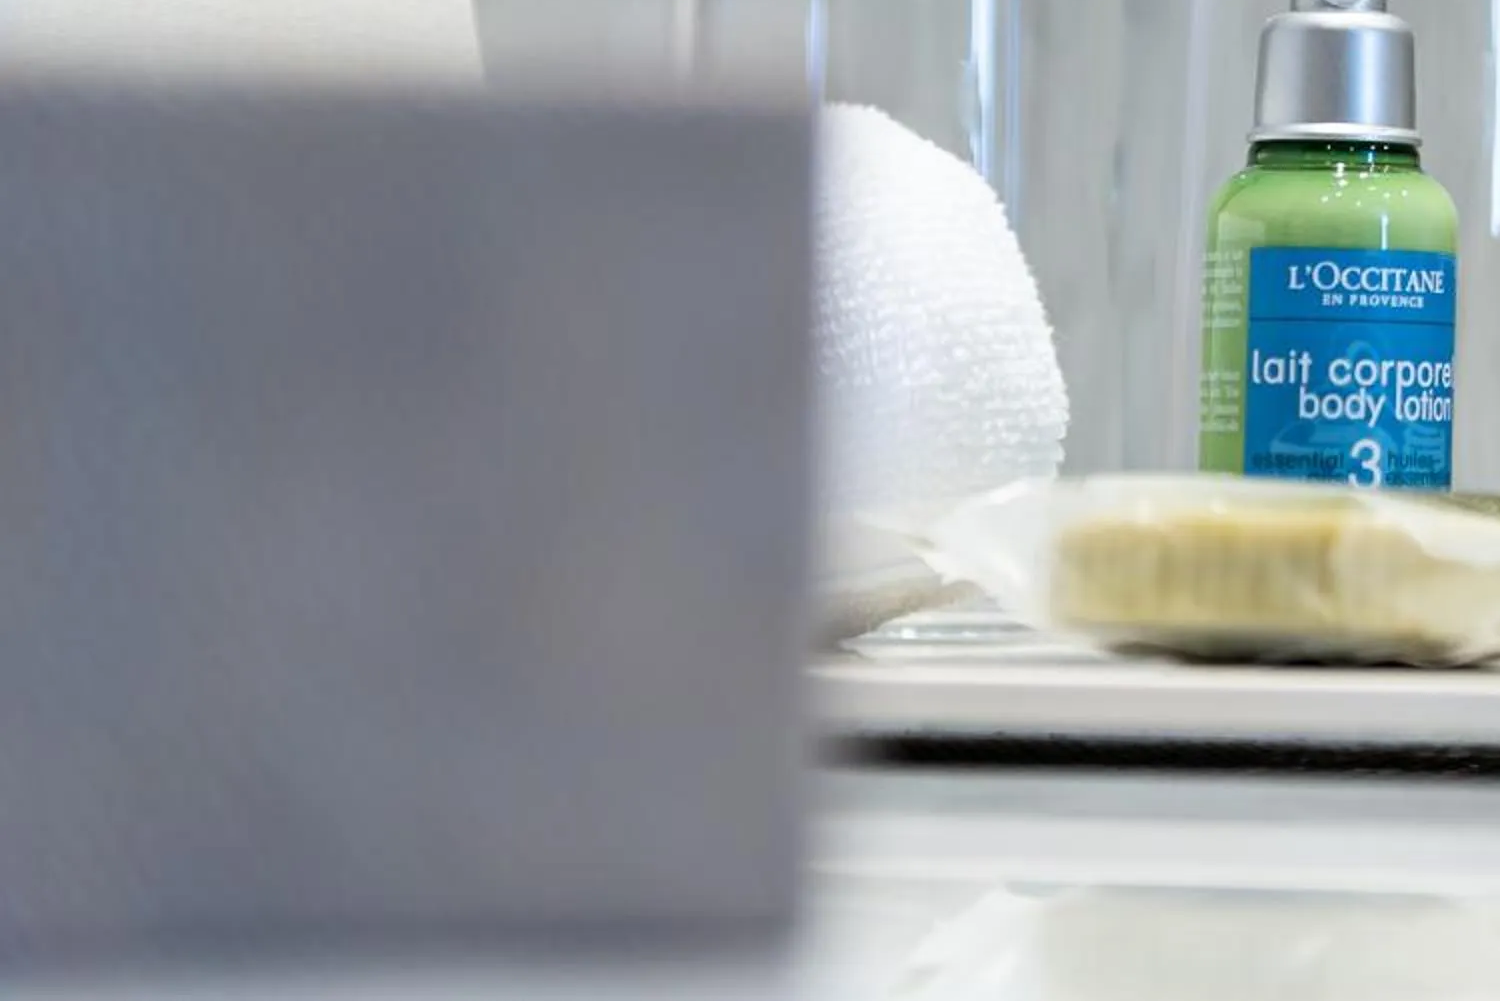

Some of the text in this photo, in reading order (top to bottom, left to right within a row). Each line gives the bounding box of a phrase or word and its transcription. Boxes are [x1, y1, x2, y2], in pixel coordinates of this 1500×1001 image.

[1287, 261, 1445, 294] L'OCCITANE
[1322, 293, 1425, 309] EN PROVENCE
[1253, 350, 1312, 384] lait
[1299, 386, 1452, 428] body lotion
[1348, 439, 1383, 489] 3
